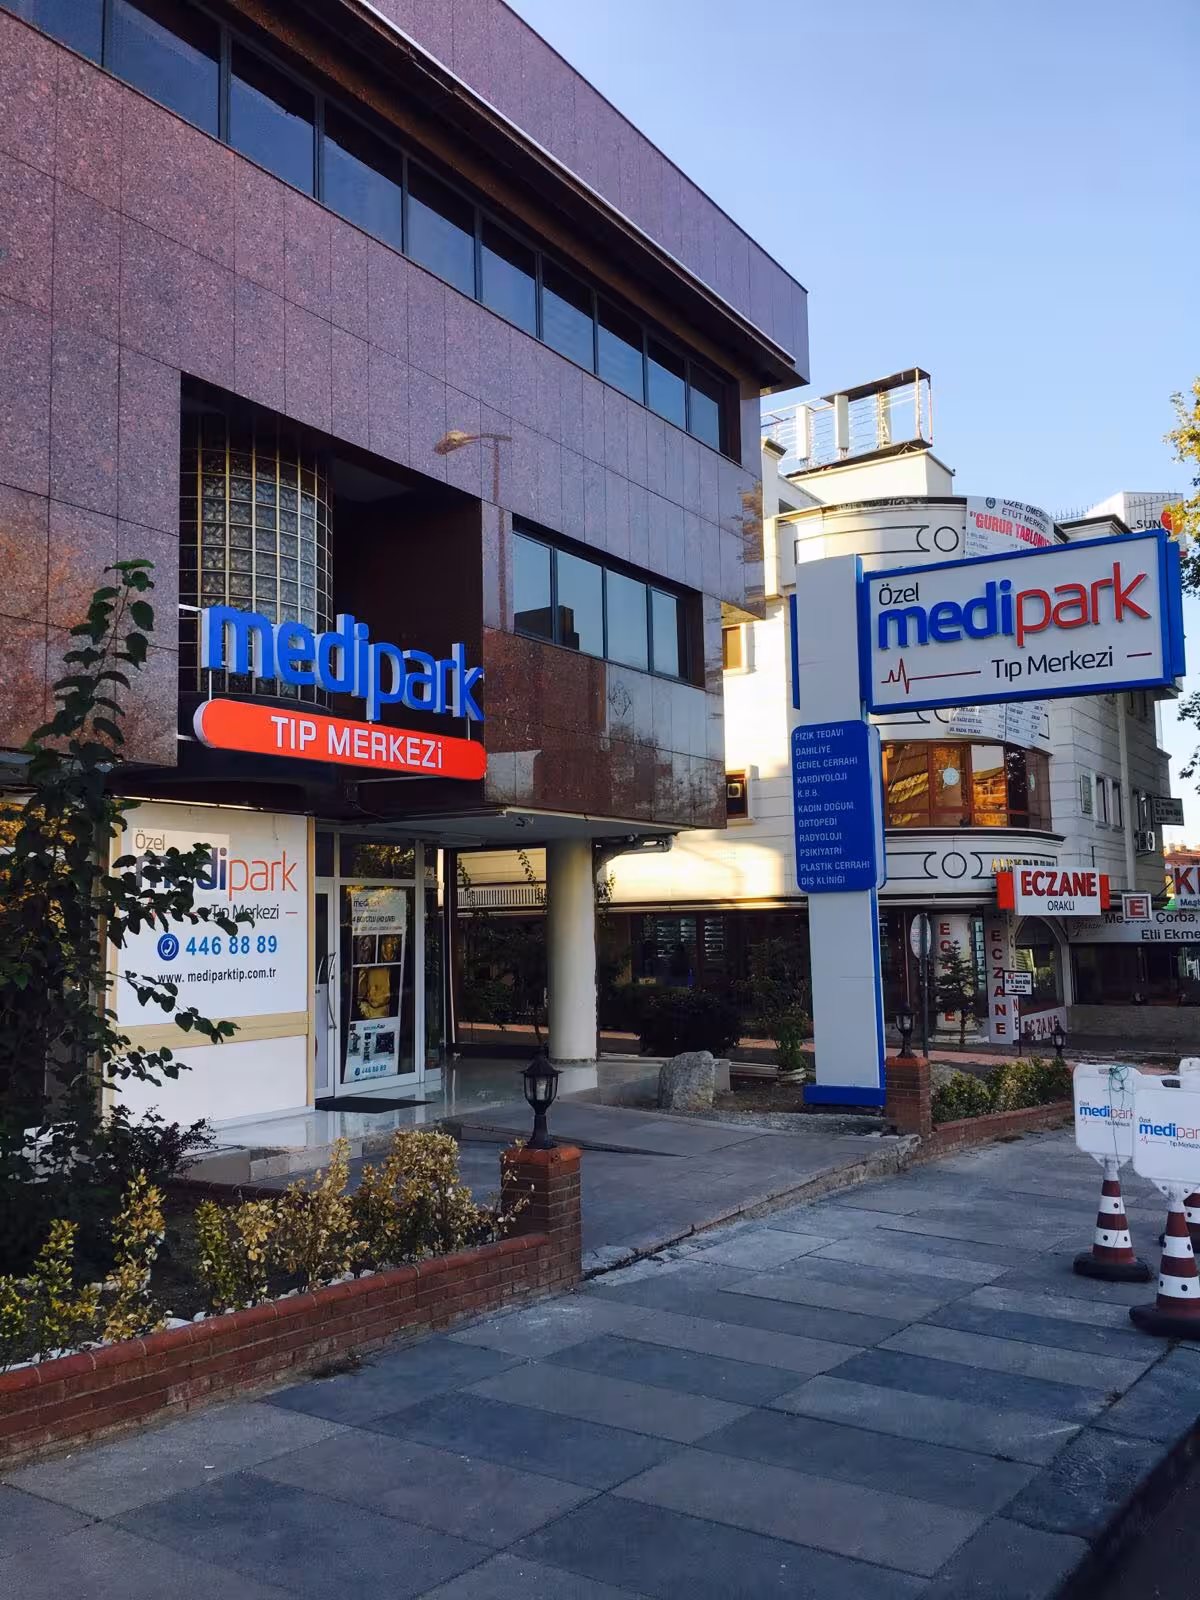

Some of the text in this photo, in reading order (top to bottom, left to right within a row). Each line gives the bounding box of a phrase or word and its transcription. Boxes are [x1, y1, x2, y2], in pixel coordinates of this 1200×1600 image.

[878, 582, 919, 606] Özel
[878, 561, 1152, 650] medipark
[201, 606, 485, 721] medipark
[1027, 646, 1113, 675] Merkezi
[270, 715, 317, 751] TIP
[796, 760, 821, 770] GENEL
[798, 803, 822, 813] KADIN
[135, 829, 165, 851] Özel
[1020, 870, 1098, 897] ECZANE
[1129, 899, 1145, 916] E
[186, 935, 278, 956] 446 88 89
[1141, 929, 1160, 940] Etli
[990, 929, 1007, 1035] ECZANE
